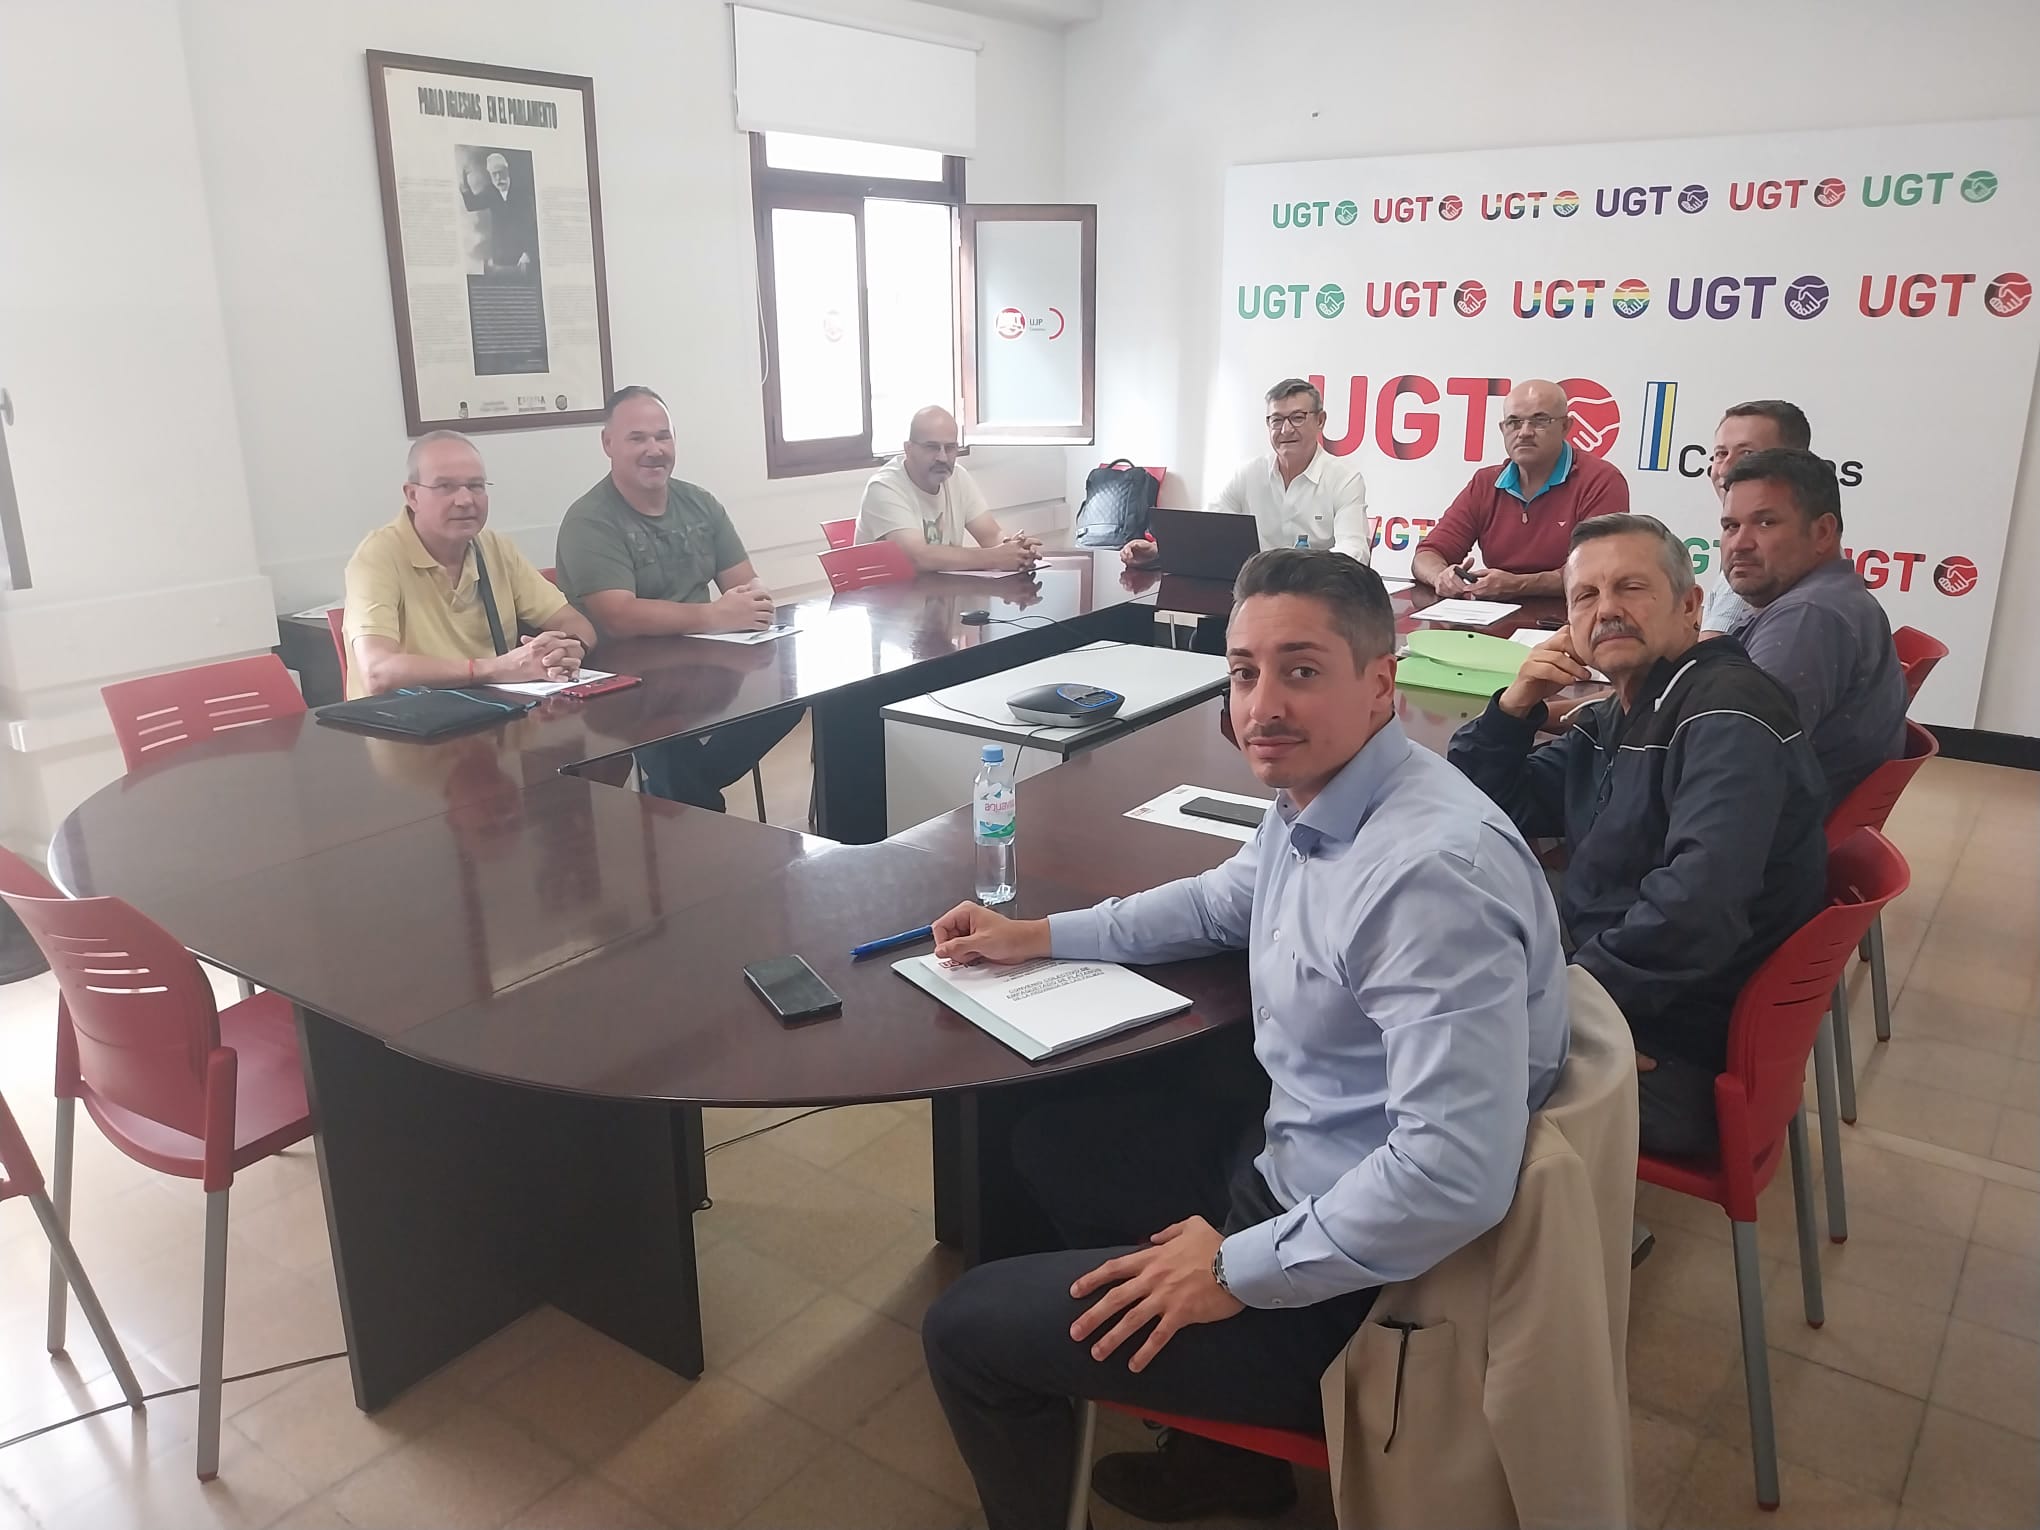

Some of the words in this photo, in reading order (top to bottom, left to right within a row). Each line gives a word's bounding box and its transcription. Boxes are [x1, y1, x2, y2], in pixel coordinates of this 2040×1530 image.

[418, 87, 445, 117] PABLO
[446, 90, 481, 120] IGLESIAS
[487, 95, 498, 123] EN
[498, 97, 508, 124] EL
[508, 98, 558, 129] PARLAMENTO
[1273, 202, 1329, 228] UGT
[1374, 197, 1433, 223] UGT
[1482, 192, 1547, 220] UGT
[1596, 186, 1672, 217] UGT
[1730, 180, 1808, 210] UGT
[1863, 173, 1953, 207] UGT
[1239, 285, 1309, 319] UGT
[1367, 281, 1447, 317] UGT
[1513, 280, 1605, 319] UGT
[1669, 277, 1776, 320] UGT
[1859, 274, 1976, 317] UGT
[1308, 375, 1512, 462] UGT
[1844, 548, 1926, 592] GT
